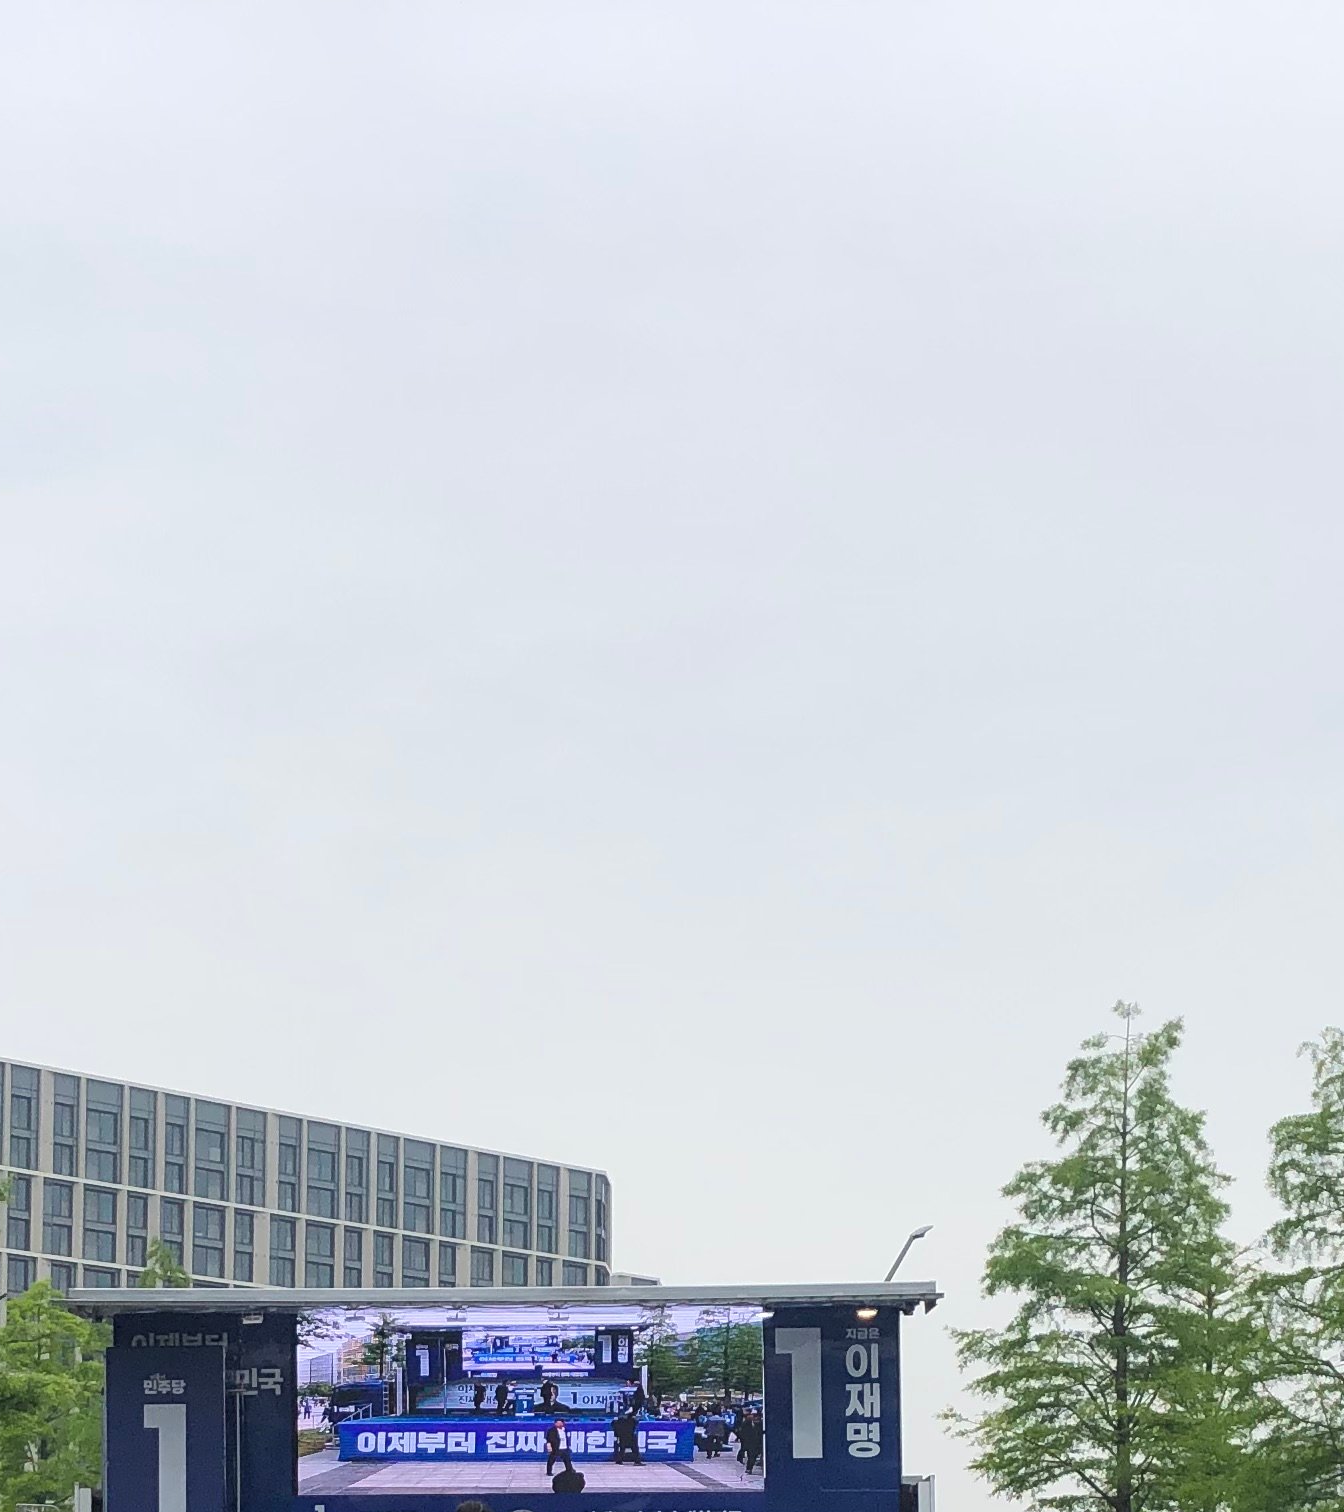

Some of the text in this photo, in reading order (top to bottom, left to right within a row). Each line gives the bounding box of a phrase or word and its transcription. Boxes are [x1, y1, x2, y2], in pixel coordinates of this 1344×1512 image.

[845, 1328, 880, 1339] 지금은
[143, 1379, 186, 1394] 민주당
[775, 1328, 823, 1458] 1
[845, 1343, 881, 1458] 이재명
[357, 1431, 476, 1454] 이제부터
[486, 1431, 547, 1454] 진짜
